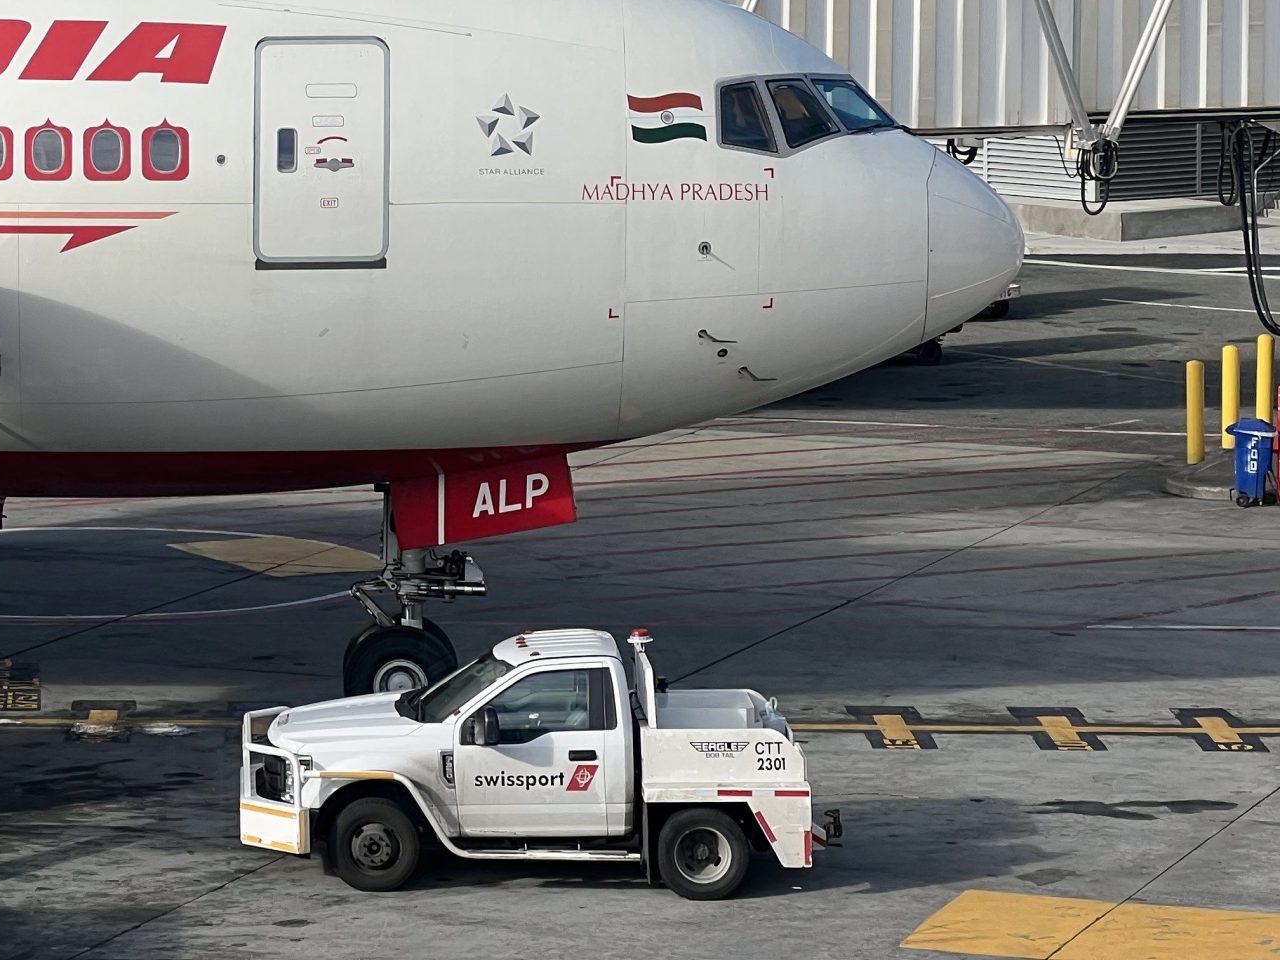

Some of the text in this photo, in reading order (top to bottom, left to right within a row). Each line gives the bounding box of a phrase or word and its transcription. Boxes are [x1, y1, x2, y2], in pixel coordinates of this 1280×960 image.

[479, 168, 545, 176] STAR ALLIANCE
[581, 183, 769, 201] MADHYA PRADESH
[1248, 436, 1259, 474] FOD
[472, 473, 550, 518] ALP
[701, 742, 739, 752] EAGLE
[754, 741, 783, 755] CTT
[757, 757, 786, 771] 2301
[474, 770, 565, 791] swissport
